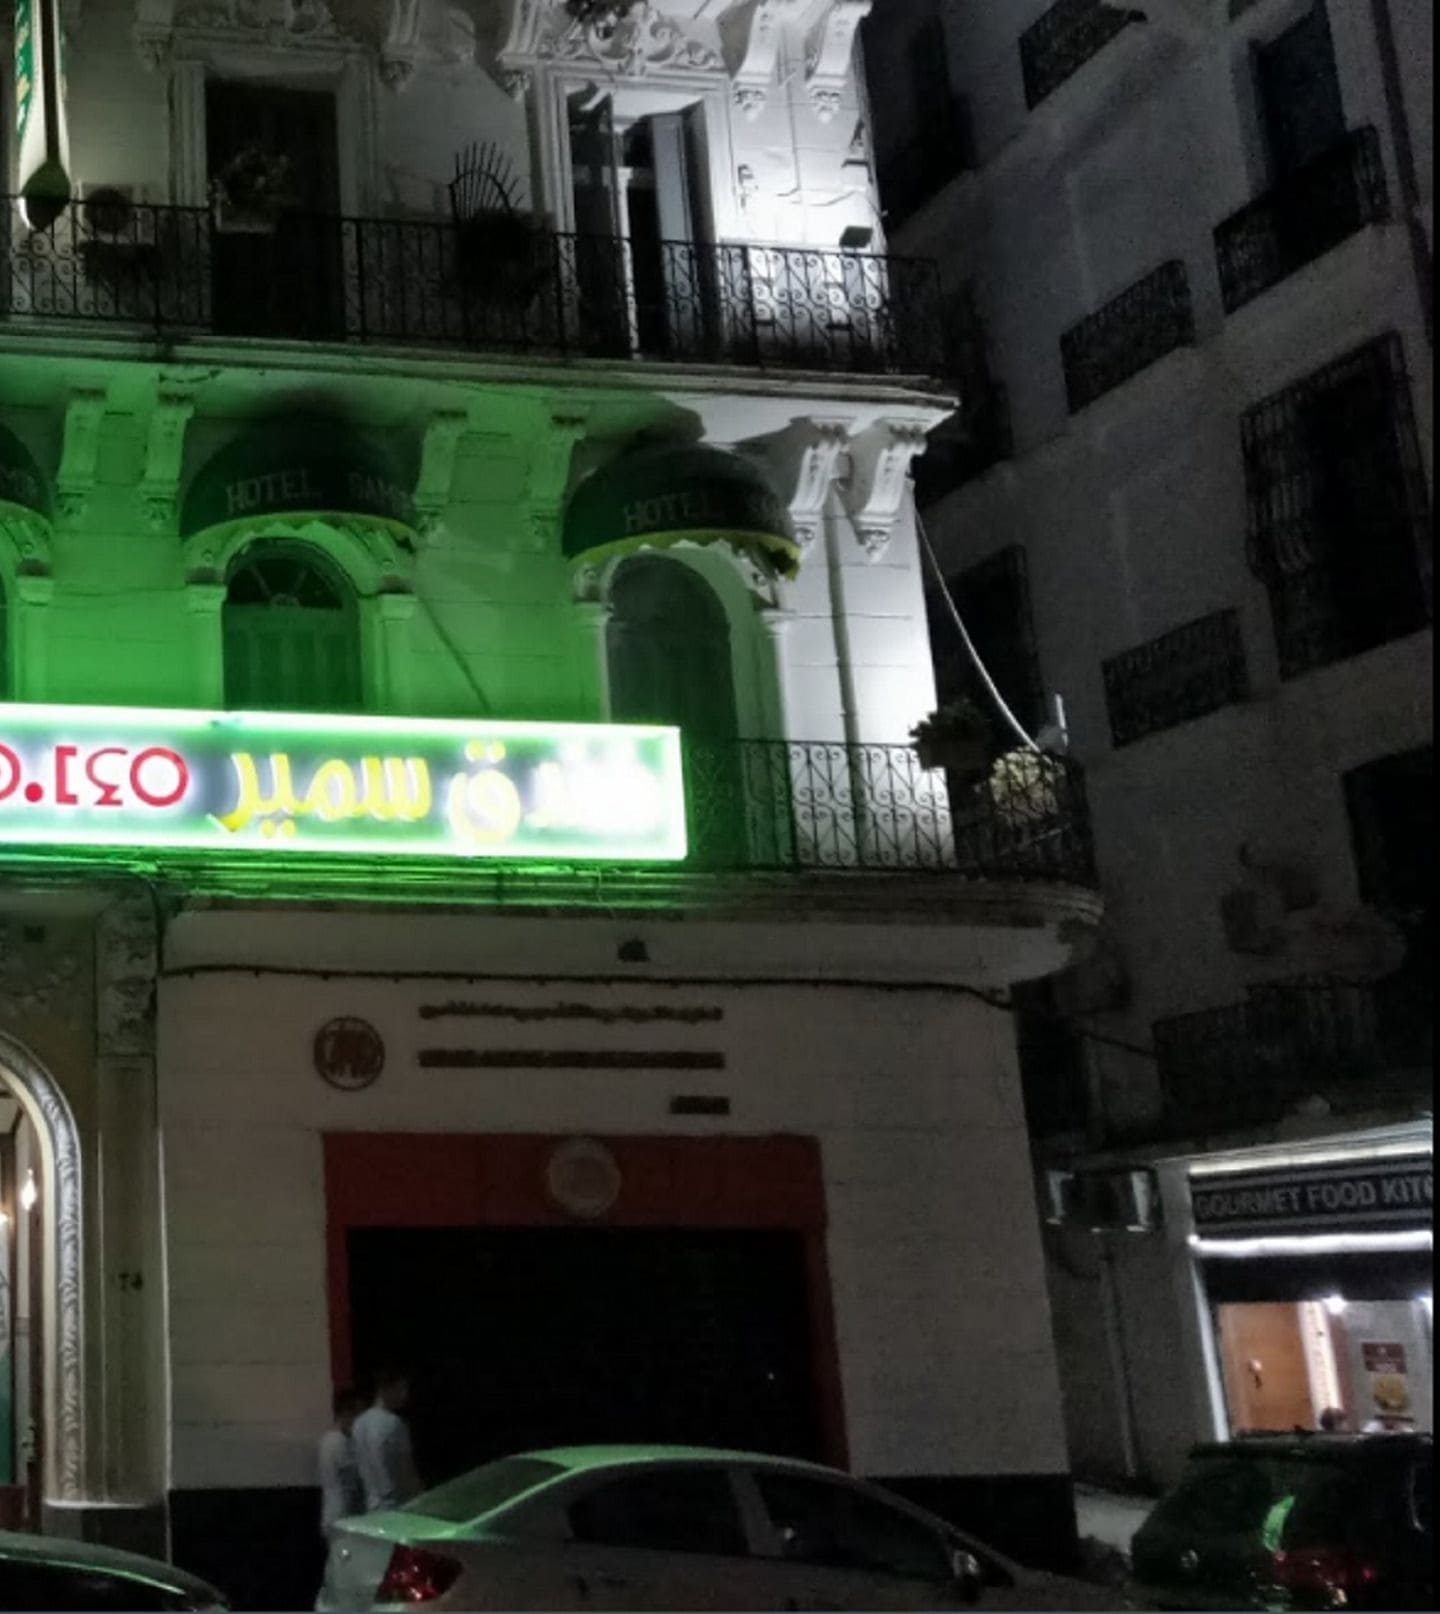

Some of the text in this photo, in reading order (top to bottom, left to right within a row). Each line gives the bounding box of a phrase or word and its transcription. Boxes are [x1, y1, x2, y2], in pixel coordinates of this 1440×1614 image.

[224, 467, 323, 515] HOTEL
[206, 752, 433, 839] سمير
[1196, 1188, 1301, 1219] GOURMET
[1308, 1179, 1377, 1209] FOOD
